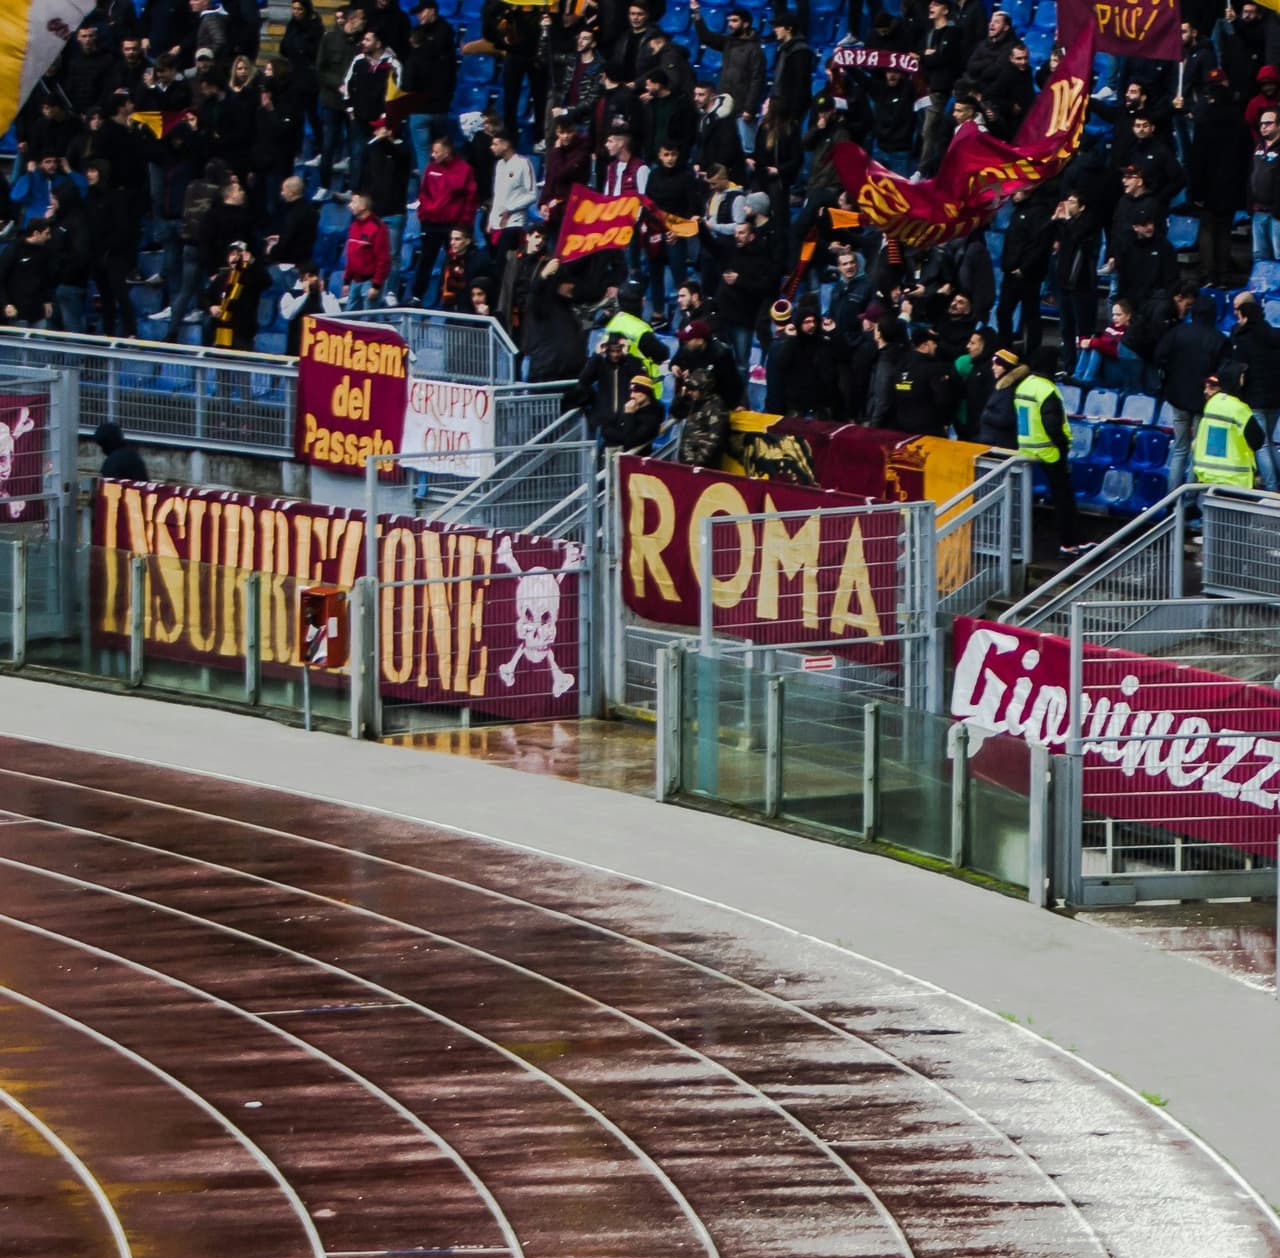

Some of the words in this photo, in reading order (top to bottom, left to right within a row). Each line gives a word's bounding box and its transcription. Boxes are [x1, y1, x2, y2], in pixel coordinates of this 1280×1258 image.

[331, 374, 373, 422] del
[410, 382, 493, 422] GRUPPO
[303, 412, 395, 473] Passato
[627, 471, 885, 646] ROMA
[101, 481, 494, 698] INSURREZONE
